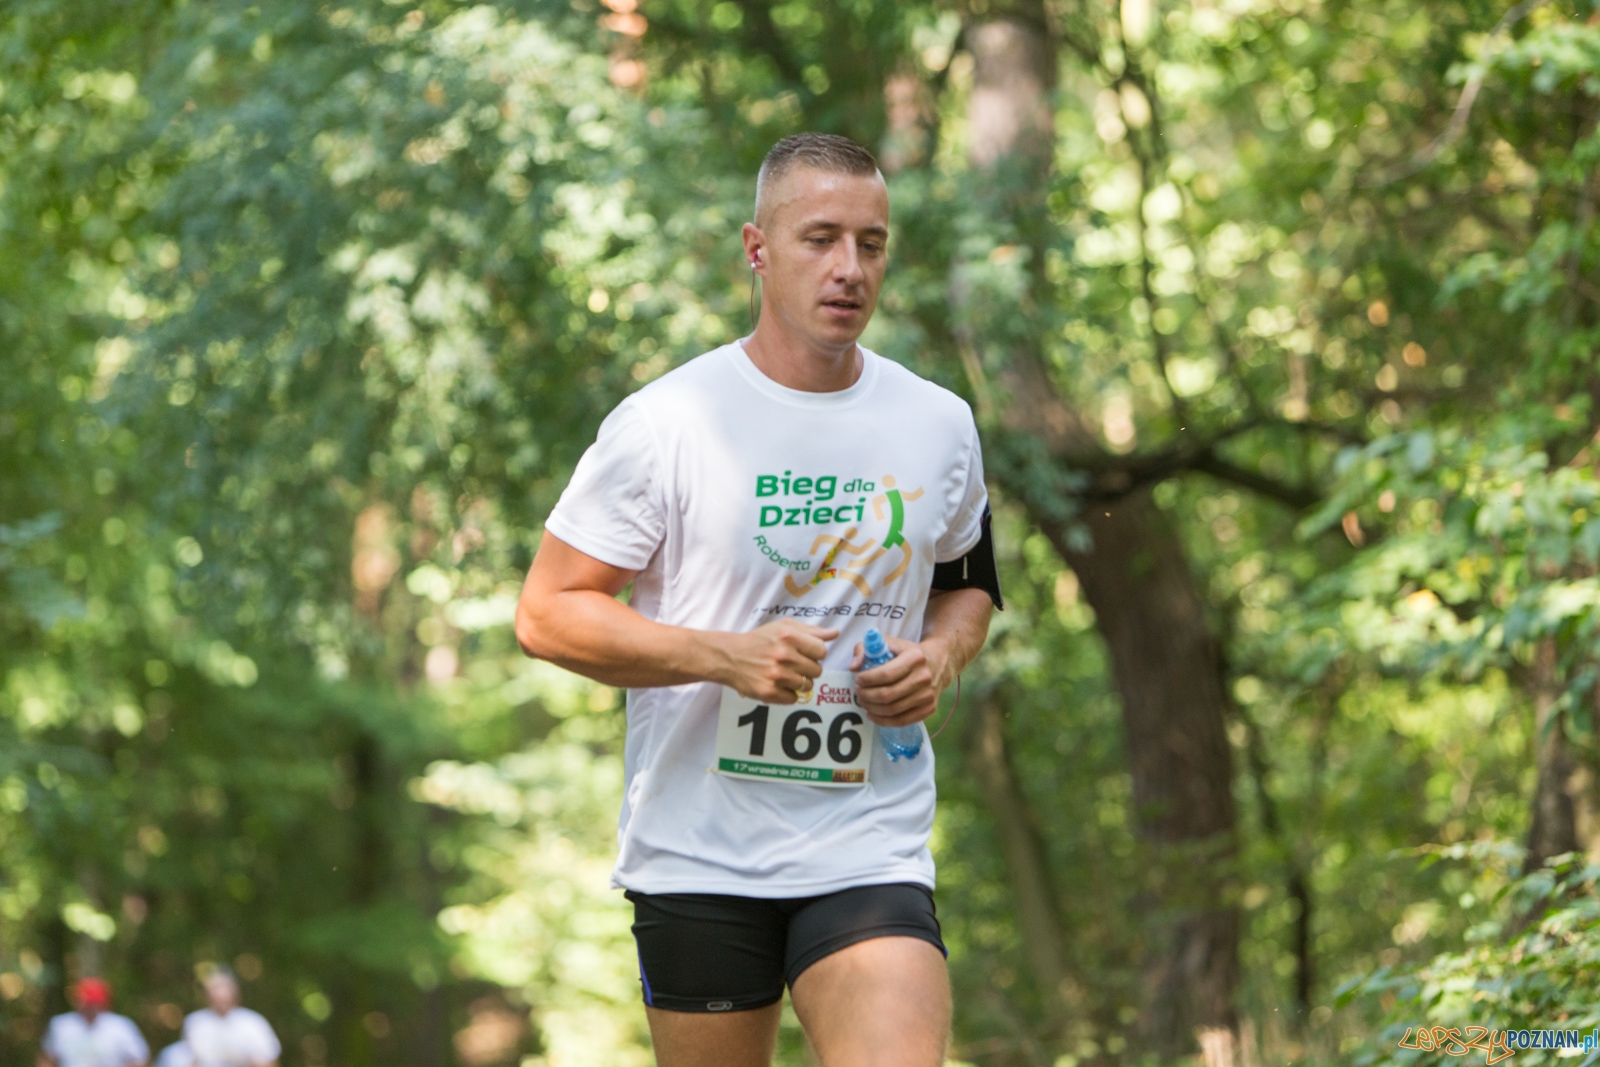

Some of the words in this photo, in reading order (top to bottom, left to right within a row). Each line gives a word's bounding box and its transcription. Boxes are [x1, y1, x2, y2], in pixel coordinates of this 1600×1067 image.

[755, 470, 838, 501] Bieg
[843, 478, 876, 493] dla
[758, 497, 866, 527] Dzieci
[753, 534, 810, 571] Roberta
[854, 602, 907, 620] 2016
[737, 704, 864, 764] 166
[733, 762, 748, 771] 17
